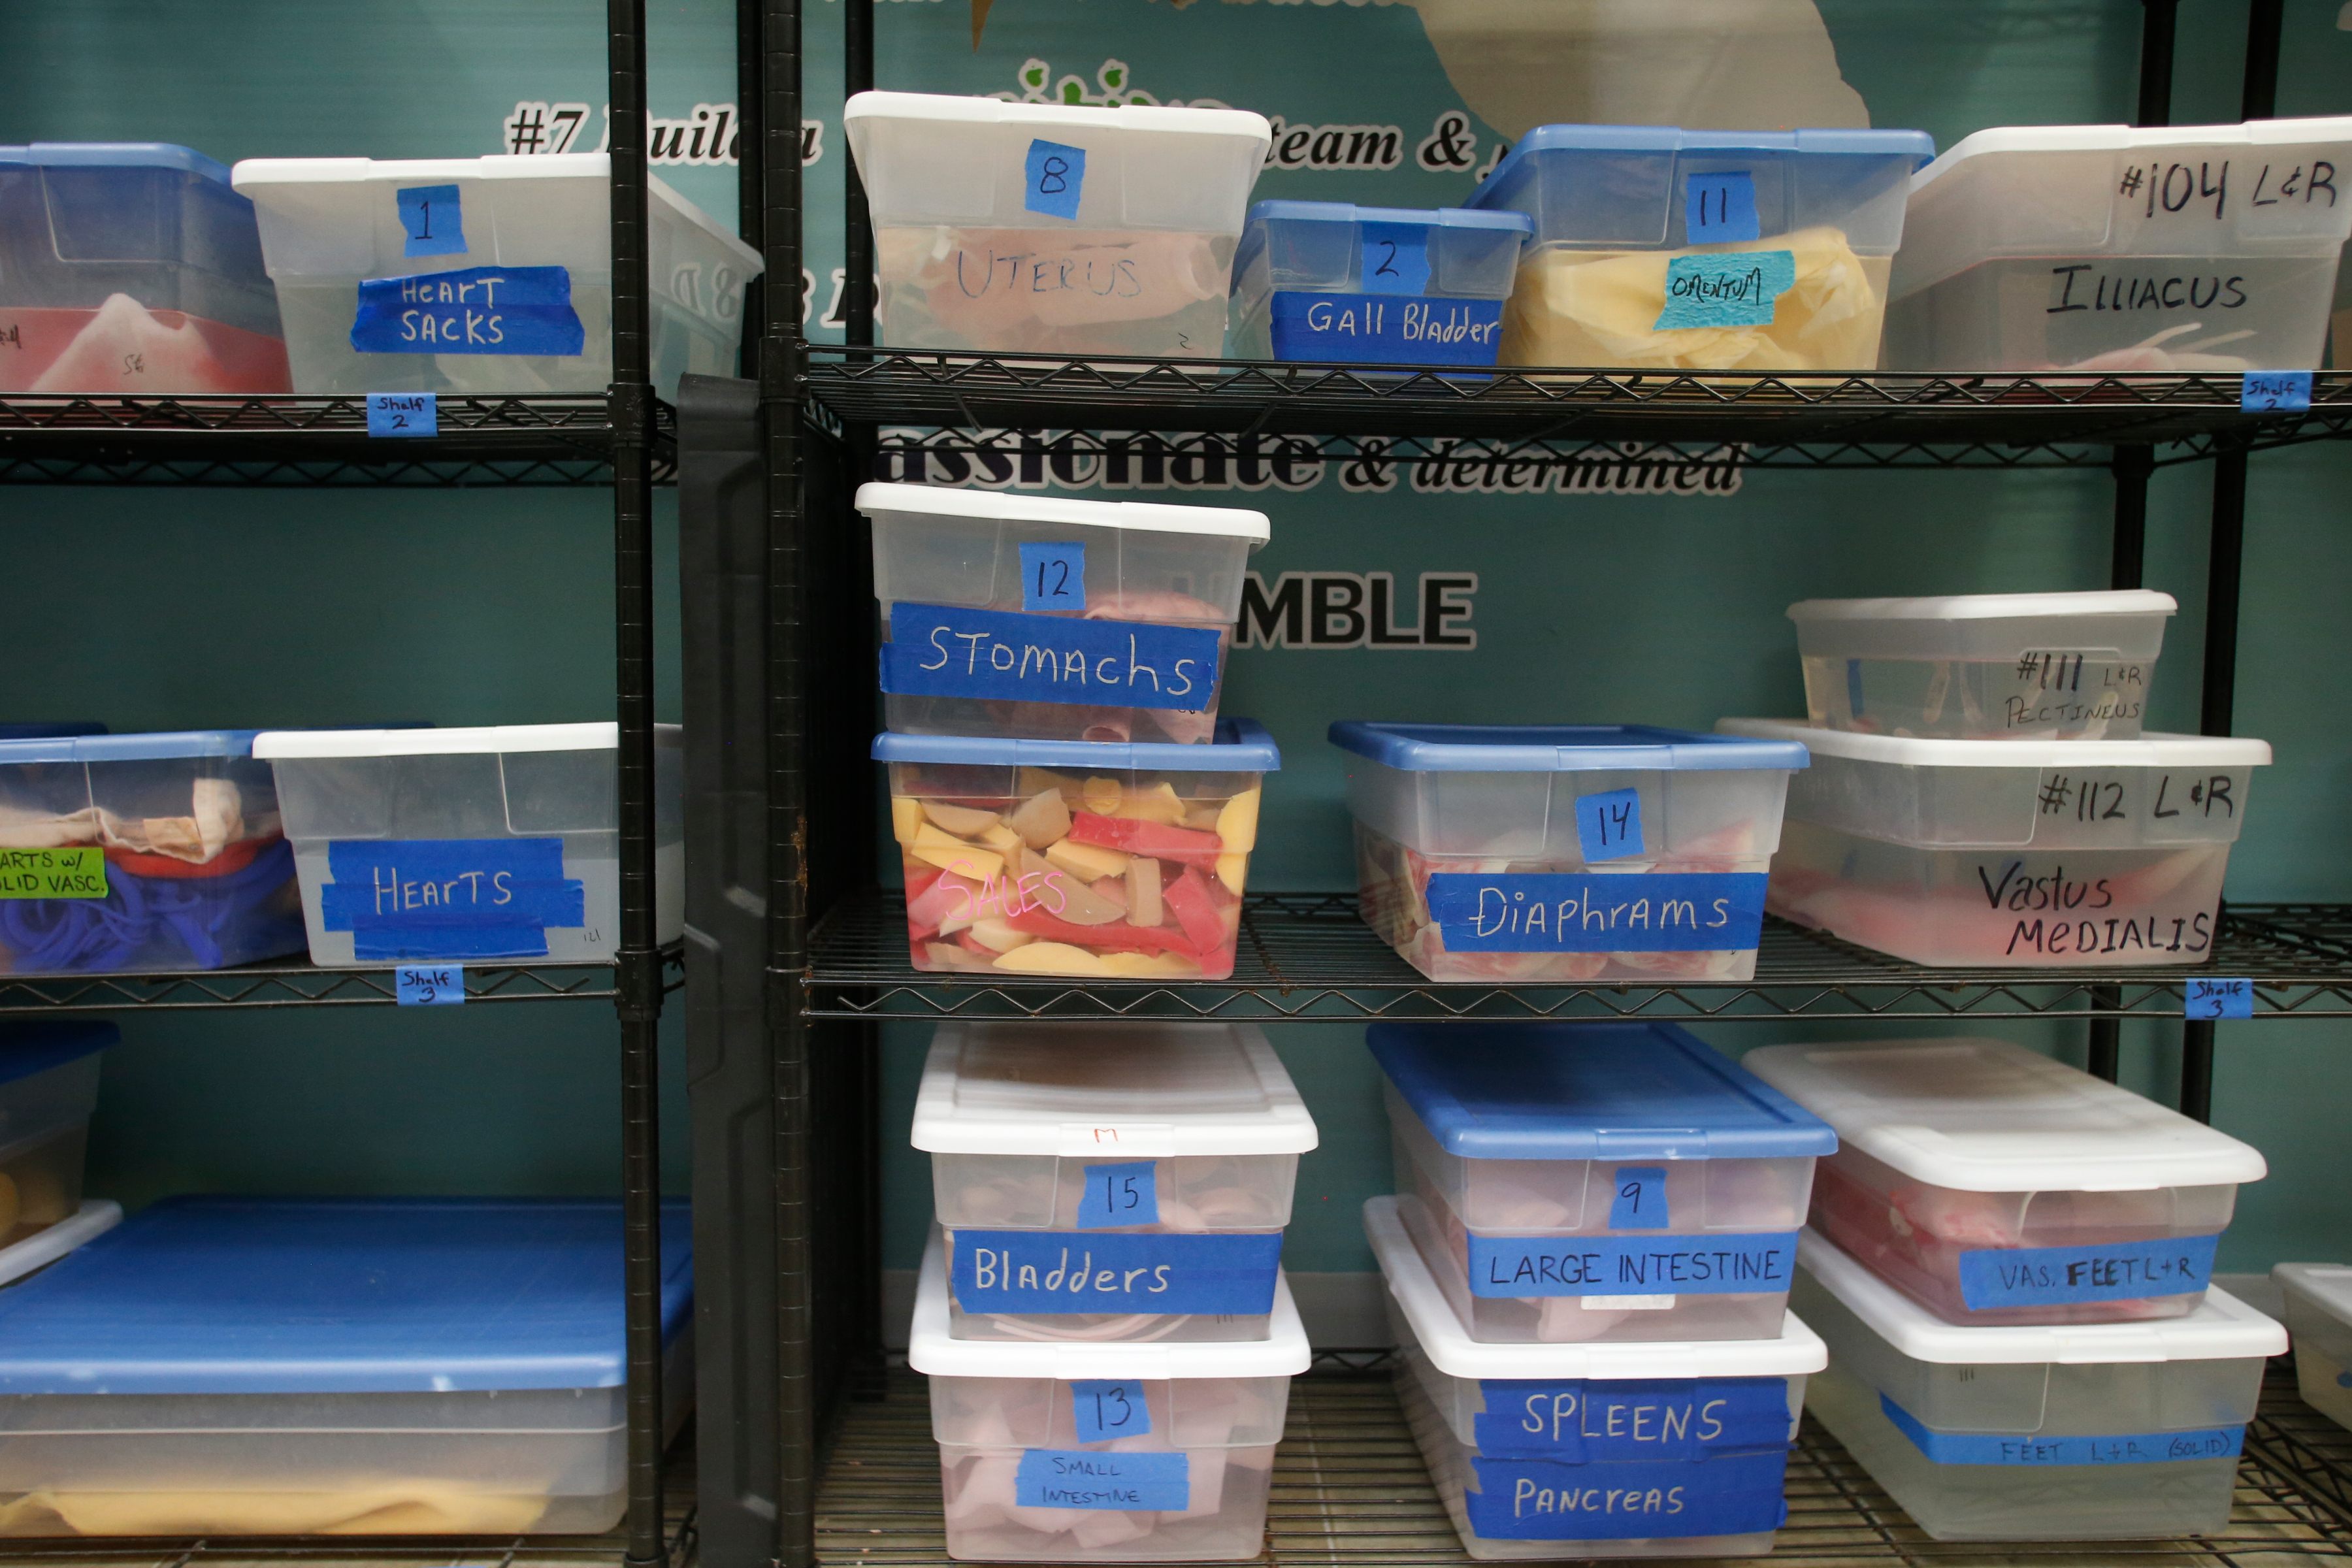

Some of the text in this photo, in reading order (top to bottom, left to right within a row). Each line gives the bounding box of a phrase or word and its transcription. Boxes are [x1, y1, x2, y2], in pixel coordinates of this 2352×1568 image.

[512, 110, 583, 154] #7
[1264, 122, 1398, 164] team
[1423, 118, 1469, 166] &
[1040, 156, 1068, 193] 8
[2119, 161, 2229, 220] #104
[414, 201, 433, 240] 1
[1700, 188, 1727, 226] 11
[958, 250, 1141, 298] UTERUS
[1375, 240, 1399, 277] 2
[1671, 267, 1762, 306] OMENTUM
[401, 309, 505, 346] SACKS
[392, 414, 410, 429] 2
[2264, 398, 2286, 412] 2
[874, 430, 1742, 491] assionate & determined
[1037, 559, 1070, 598] 12
[1236, 578, 1473, 645] MBLE
[2017, 651, 2083, 692] #111
[2005, 695, 2140, 729] PECTINEUS
[2038, 774, 2125, 821] #112
[1599, 801, 1631, 845] 14
[0, 851, 54, 871] ARTS
[0, 874, 105, 893] LID VASC.
[1978, 862, 2112, 912] Vastus
[418, 987, 436, 1003] 3
[2204, 999, 2224, 1018] 3
[1107, 1176, 1139, 1213] 15
[1620, 1181, 1641, 1213] 9
[1490, 1250, 1782, 1284] LARGE INTESTINE
[1999, 1264, 2056, 1290] VAS.
[2066, 1258, 2139, 1286] FEET
[1096, 1386, 1131, 1431] 13
[1521, 1392, 1727, 1443] SPLEENS
[2001, 1442, 2063, 1461] FEET
[2168, 1431, 2231, 1458] (SOLID)
[1052, 1457, 1121, 1476] SMALL
[1042, 1486, 1141, 1504] INTESTINE
